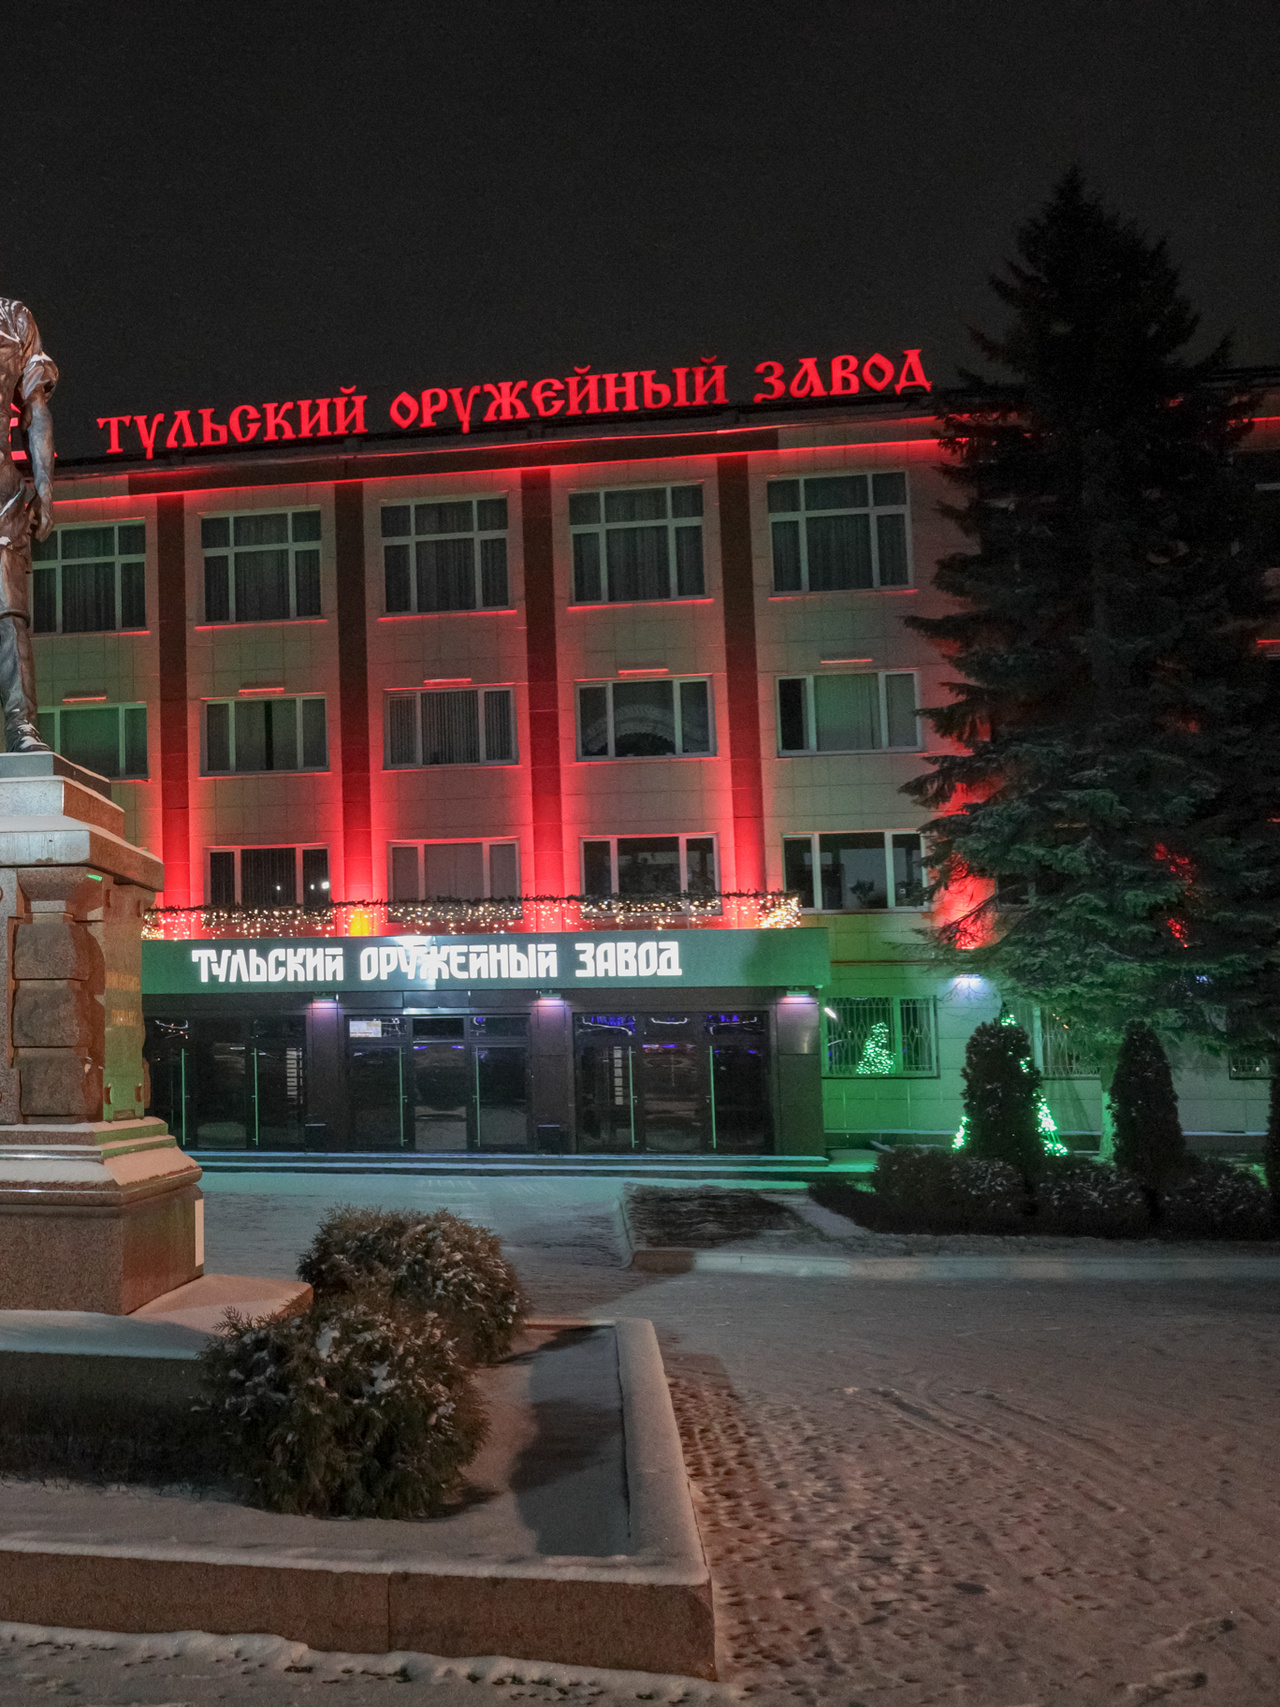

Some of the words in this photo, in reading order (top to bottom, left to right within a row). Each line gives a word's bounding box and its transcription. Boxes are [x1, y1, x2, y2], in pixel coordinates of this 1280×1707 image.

[96, 385, 369, 460] ТУЛЬСКИЙ
[389, 356, 729, 434] ОРУЖЕЙНЫЙ
[753, 348, 934, 403] ЗАВОД
[191, 947, 344, 983] ТУЛЬСКИЙ
[359, 943, 558, 981] ОРУЖЕЙНЫЙ
[574, 941, 683, 977] ЗАВОД
